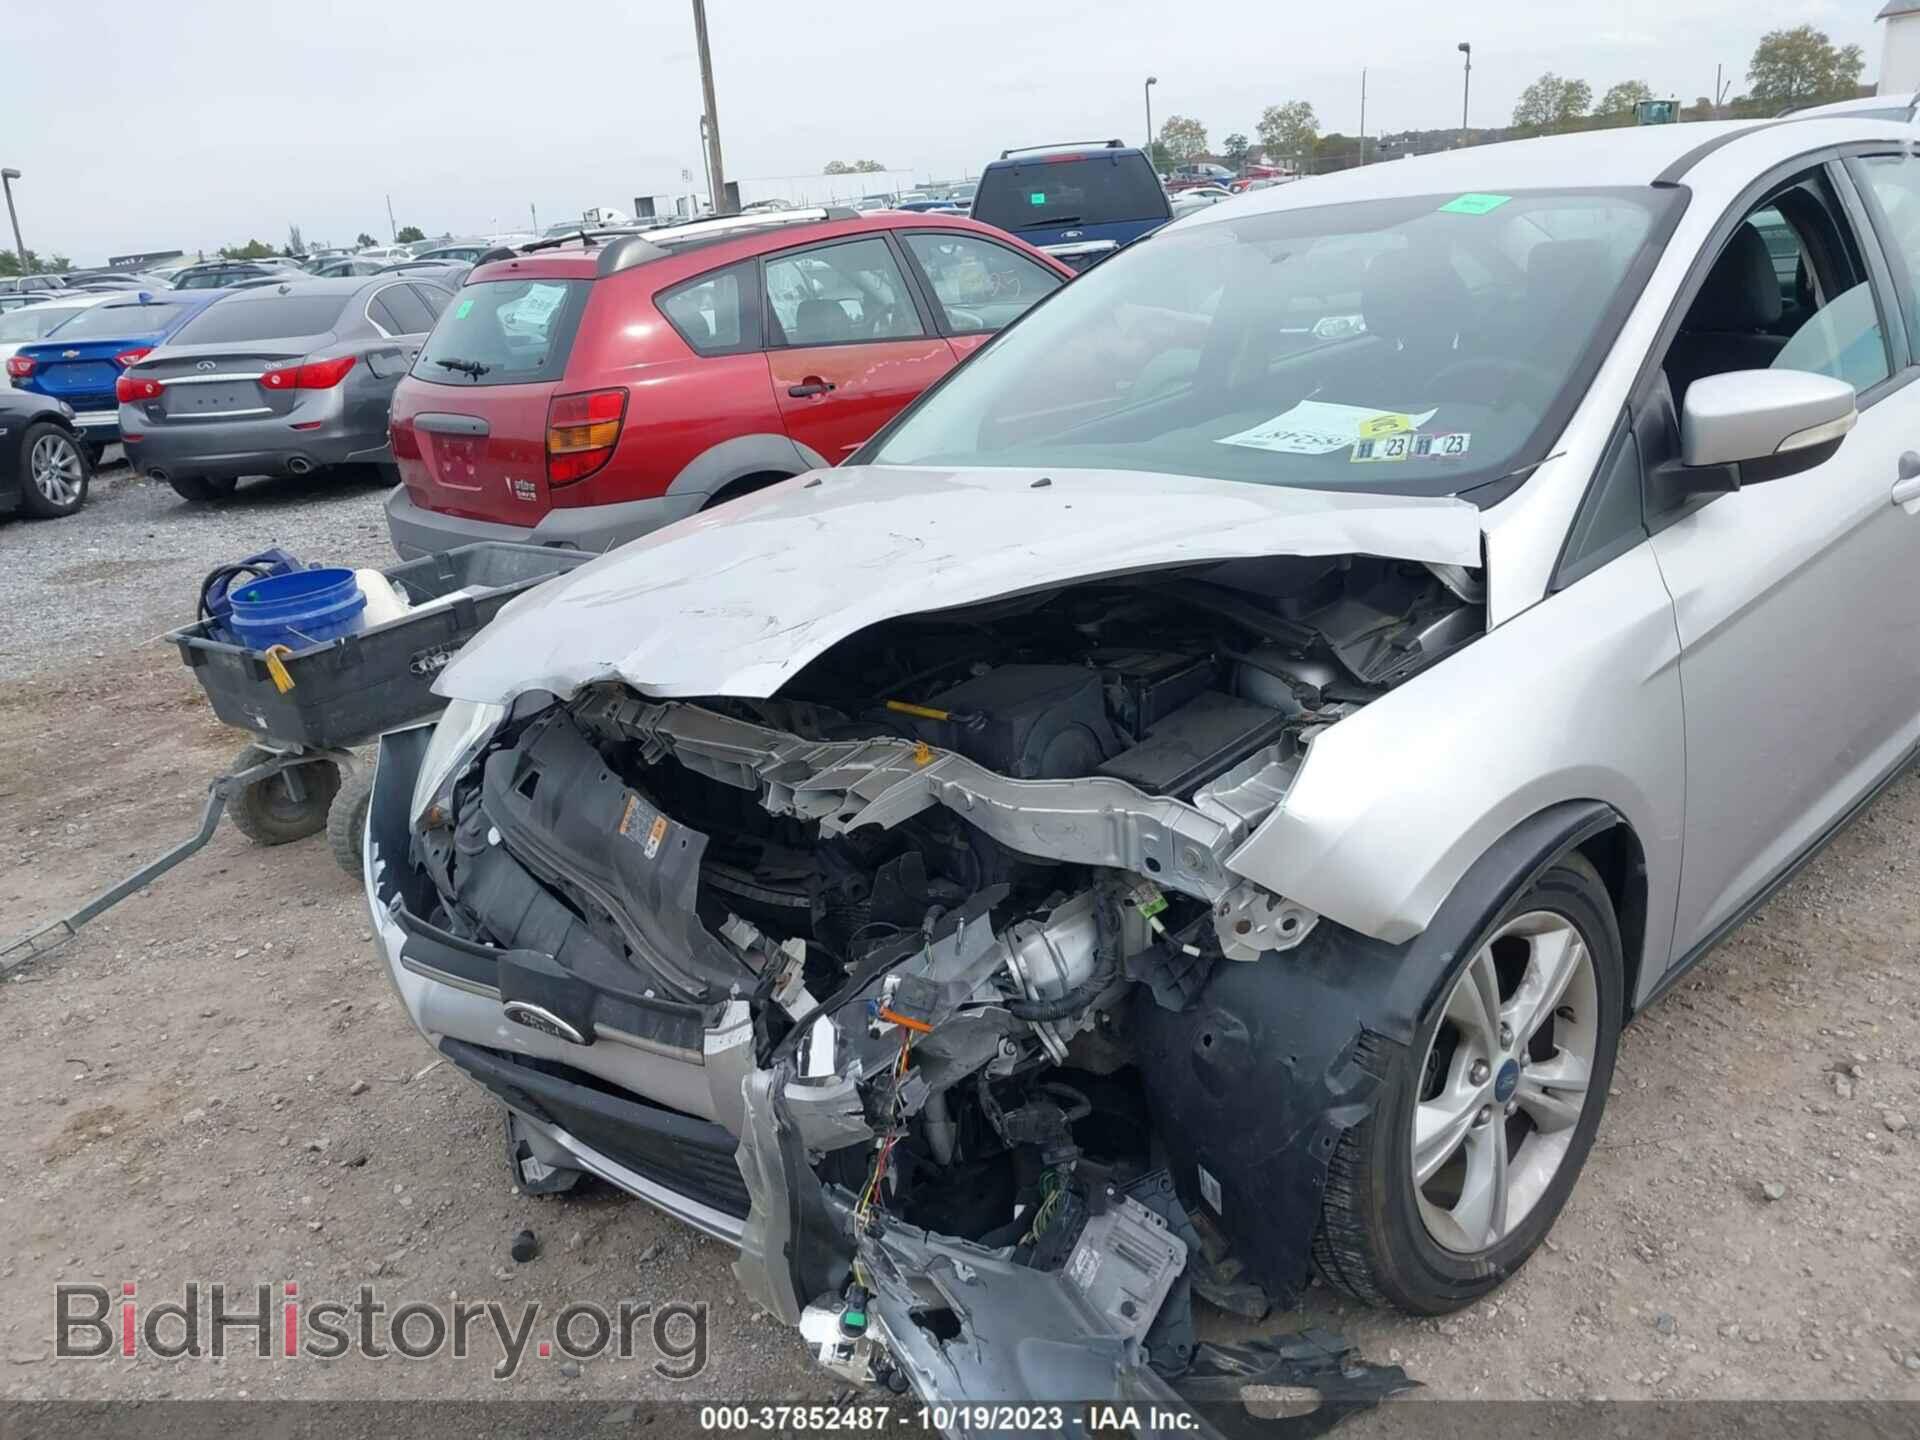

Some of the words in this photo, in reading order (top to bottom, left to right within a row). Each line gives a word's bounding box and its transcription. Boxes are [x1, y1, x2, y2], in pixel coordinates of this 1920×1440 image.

[1387, 438, 1405, 456] 23
[1416, 438, 1431, 455] 11
[1446, 435, 1464, 453] 23
